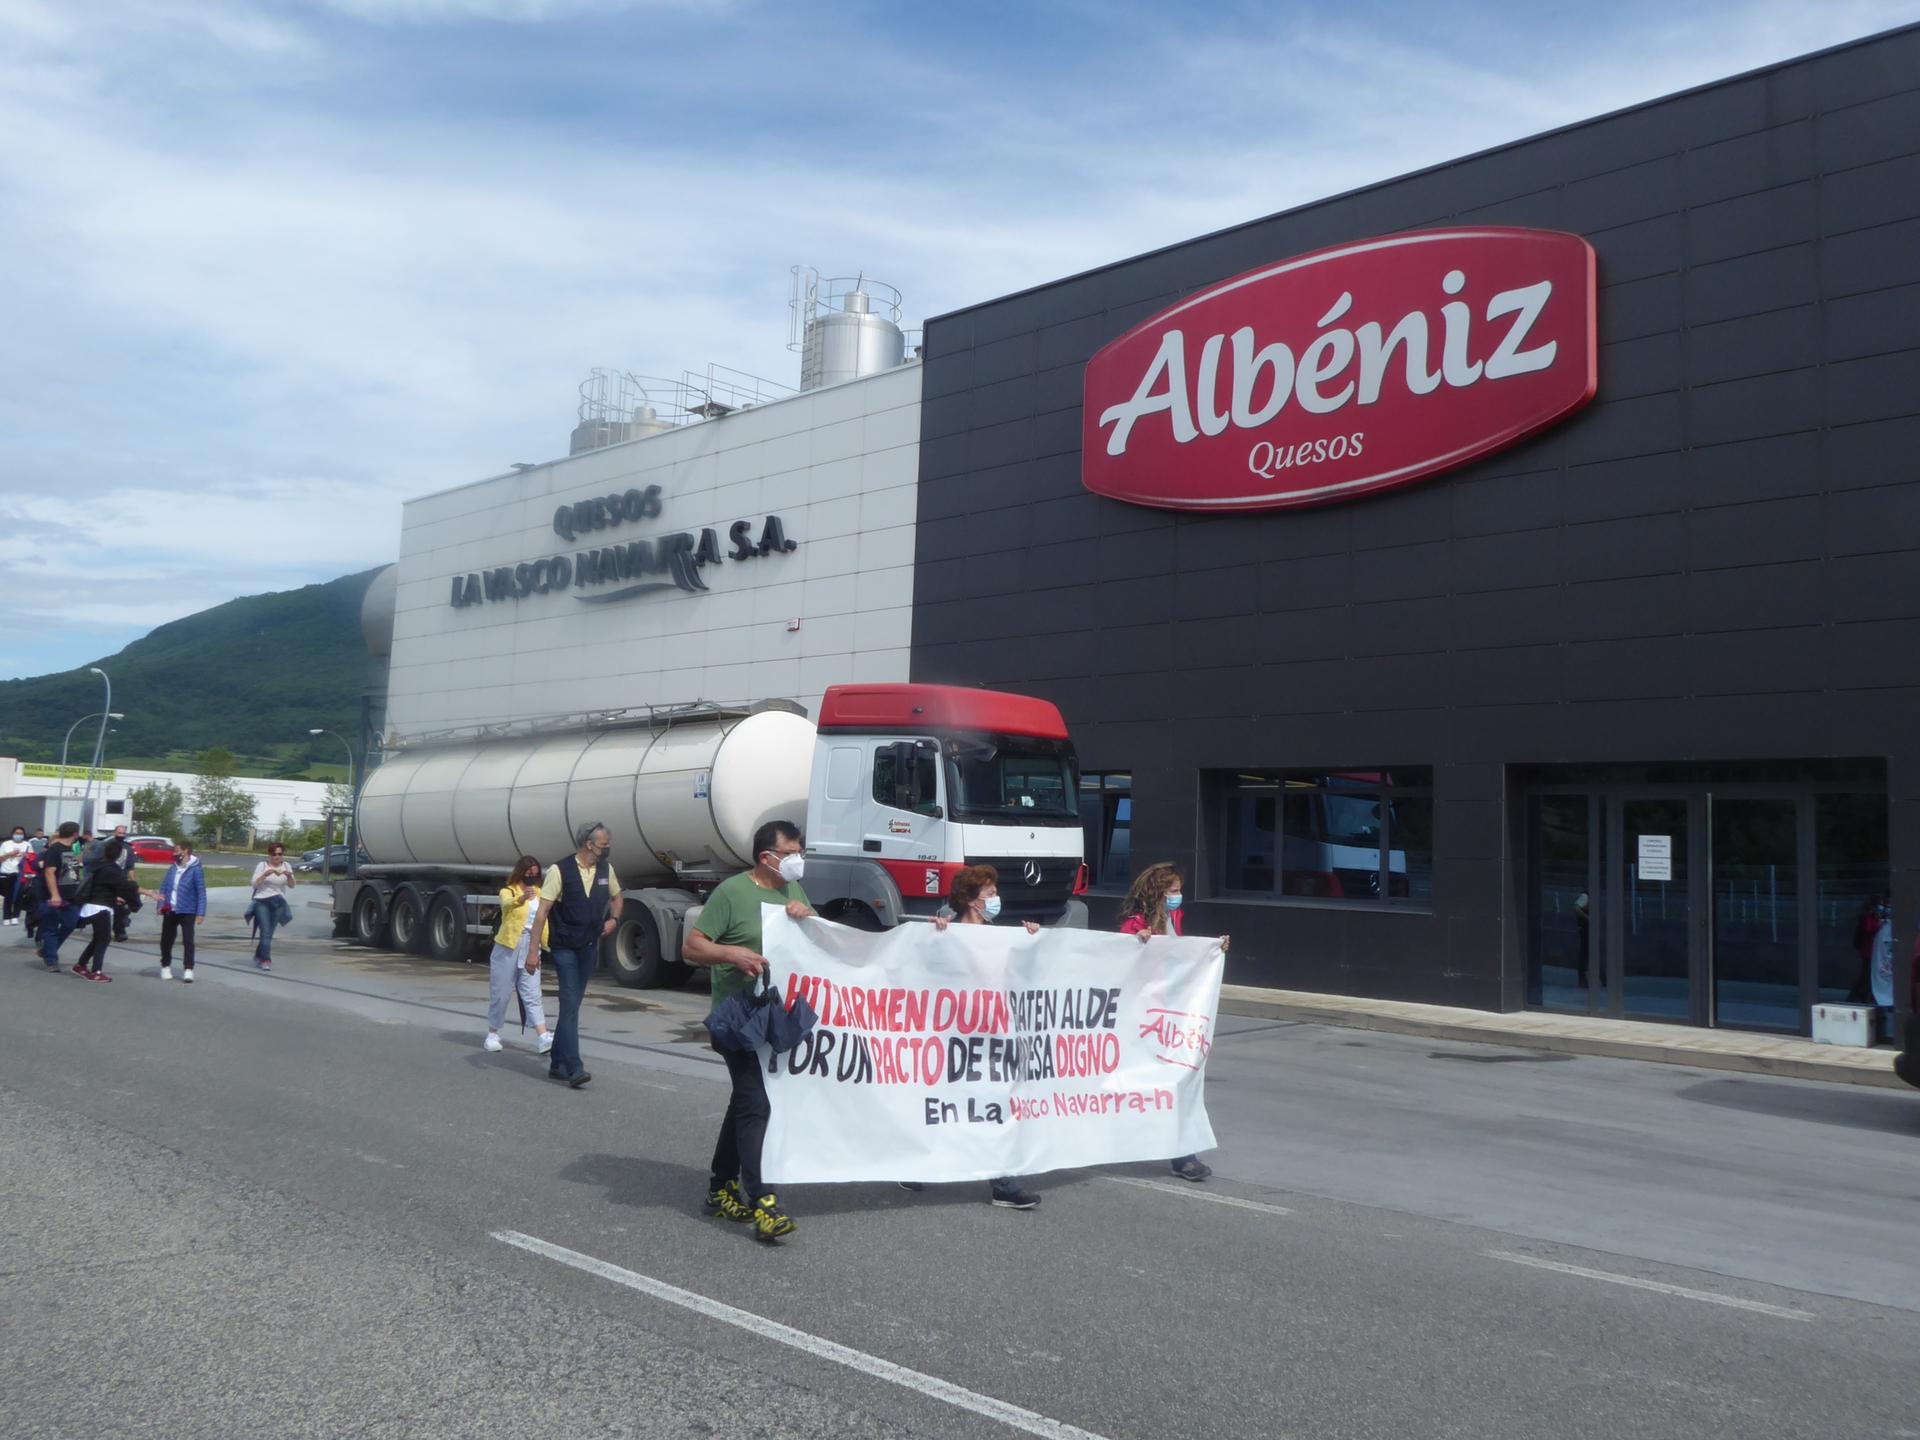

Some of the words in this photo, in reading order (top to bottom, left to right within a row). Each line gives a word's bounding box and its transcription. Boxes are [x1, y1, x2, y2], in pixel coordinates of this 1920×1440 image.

[1099, 269, 1558, 456] Albéniz
[1248, 431, 1364, 478] Quesos
[553, 484, 662, 542] QUESOS
[728, 515, 797, 561] S.A.
[933, 987, 1010, 1035] DUIN
[1061, 987, 1121, 1030] ALDE
[768, 1029, 836, 1077] OR
[837, 1032, 872, 1084] UN
[871, 1036, 945, 1086] PACTO
[948, 1037, 985, 1083] DE
[989, 1033, 1055, 1083] EMESA
[1056, 1033, 1121, 1079] DIGNO
[925, 1097, 959, 1125] En
[968, 1097, 1003, 1125] La
